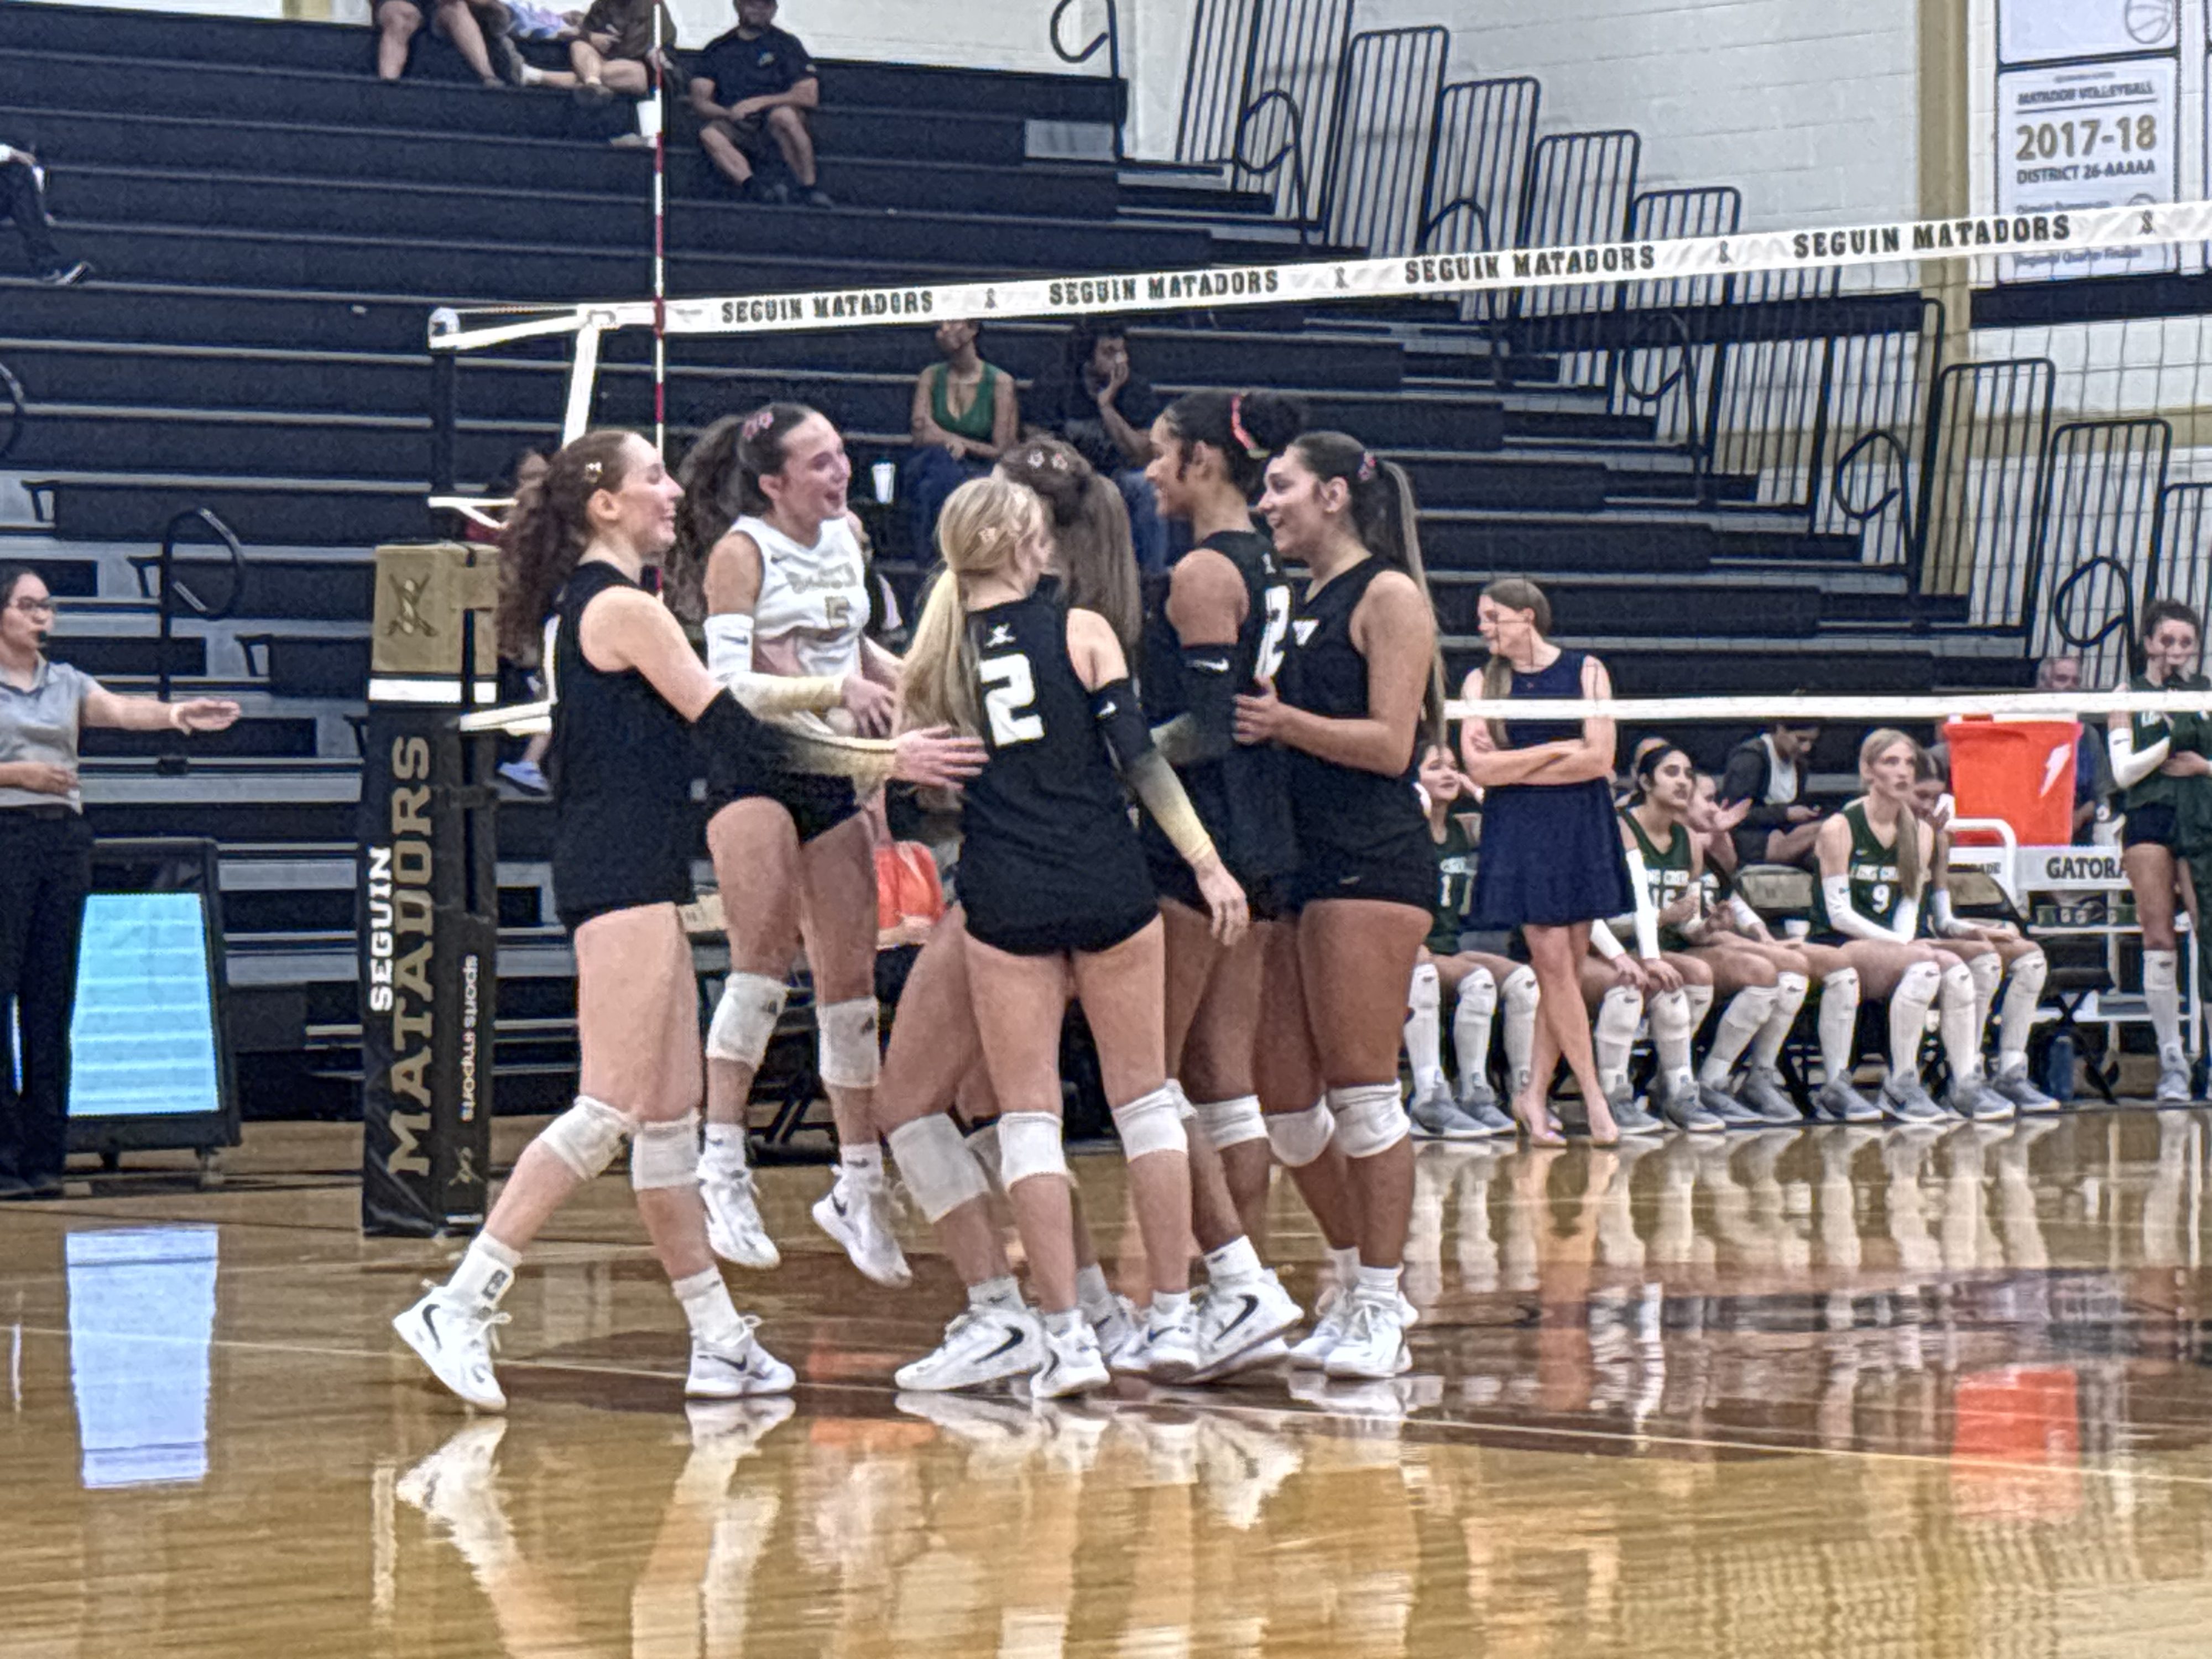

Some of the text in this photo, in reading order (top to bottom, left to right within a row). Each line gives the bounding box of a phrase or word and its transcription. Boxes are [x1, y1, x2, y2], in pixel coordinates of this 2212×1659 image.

[2016, 114, 2157, 161] 2017-18
[2016, 165, 2080, 185] DISTRICT
[721, 215, 2070, 324] SEGUIN MATADORS SEGUIN MATADORS SEGUIN MATADORS SEGUIN MATADORS
[979, 653, 1045, 747] 2
[369, 846, 393, 1011] SEGUIN
[1872, 884, 1889, 914] 9
[388, 736, 434, 1176] MATADORS
[463, 954, 478, 1029] sports
